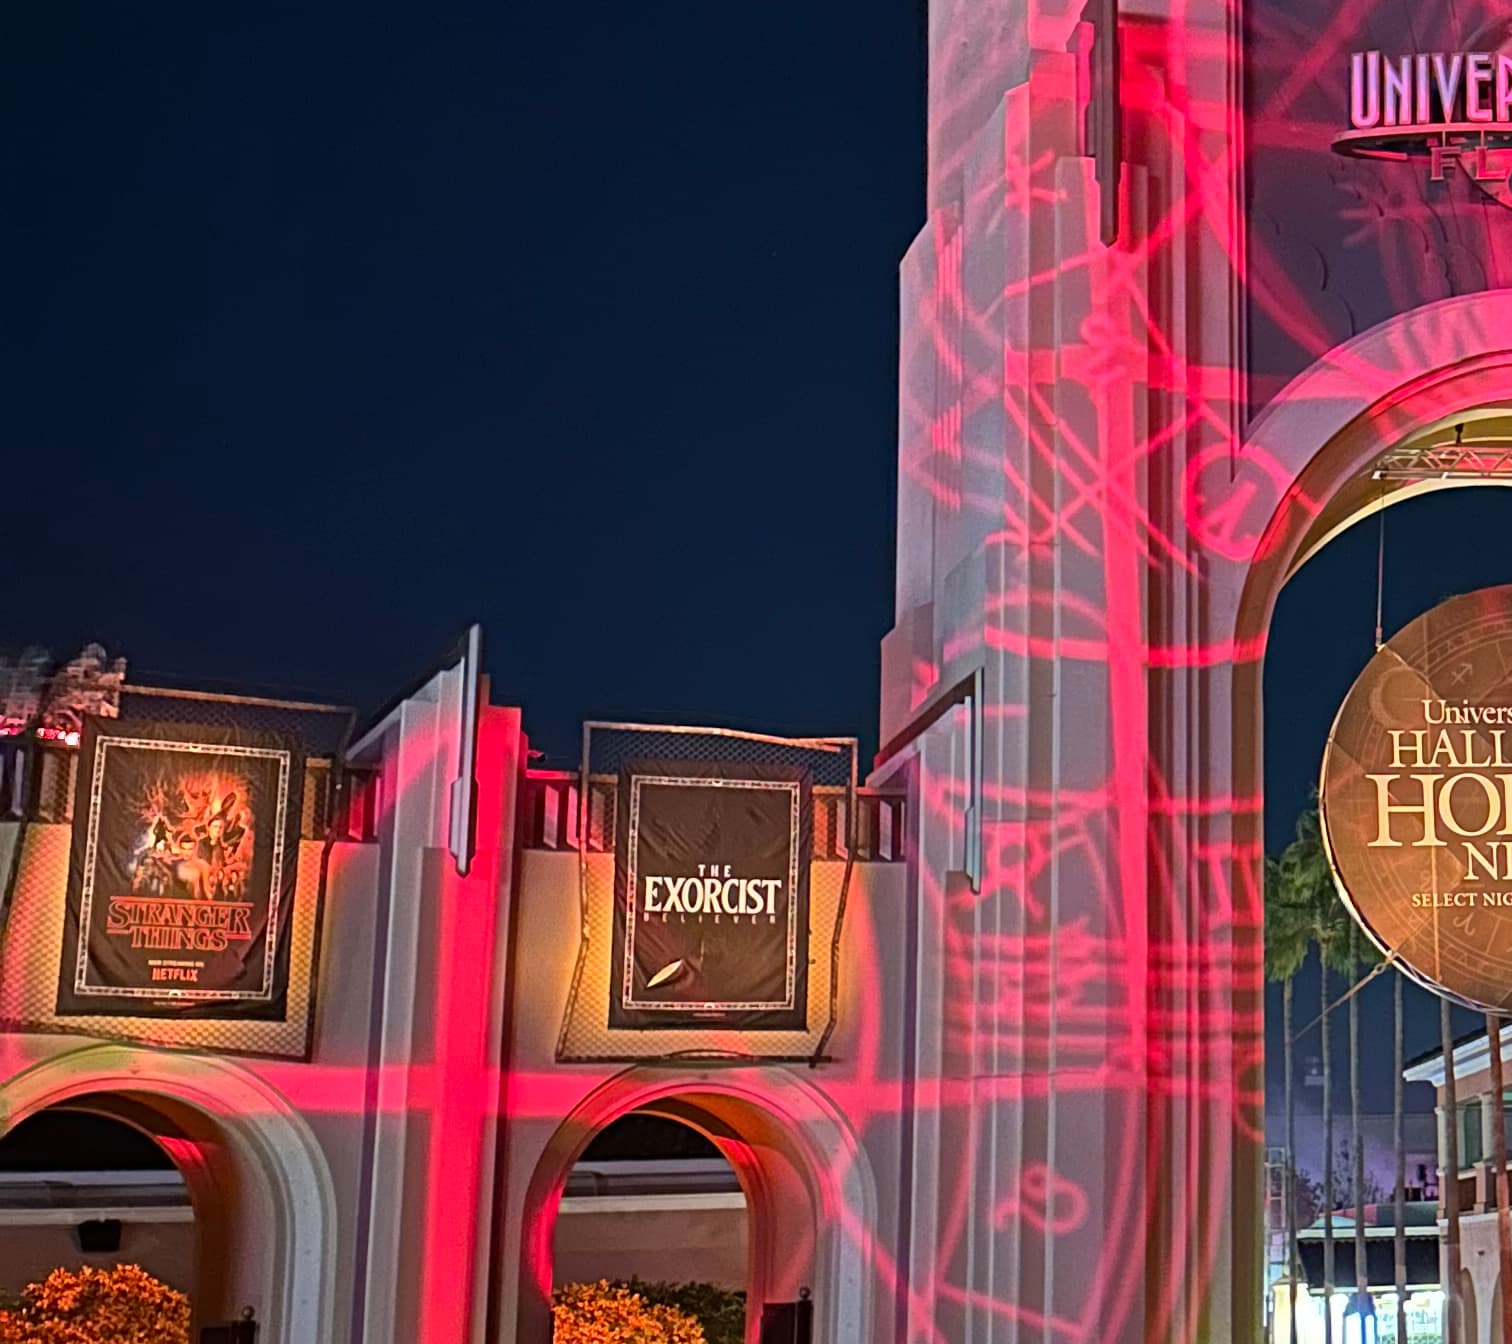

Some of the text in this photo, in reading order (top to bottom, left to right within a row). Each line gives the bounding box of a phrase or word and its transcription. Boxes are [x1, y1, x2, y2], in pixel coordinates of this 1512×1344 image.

[697, 863, 732, 878] THE
[644, 875, 783, 915] EXORCIST
[1411, 892, 1478, 908] SELECT
[106, 901, 252, 934] STRANGER
[130, 926, 229, 952] THINGS
[151, 967, 199, 982] NETFLIX
